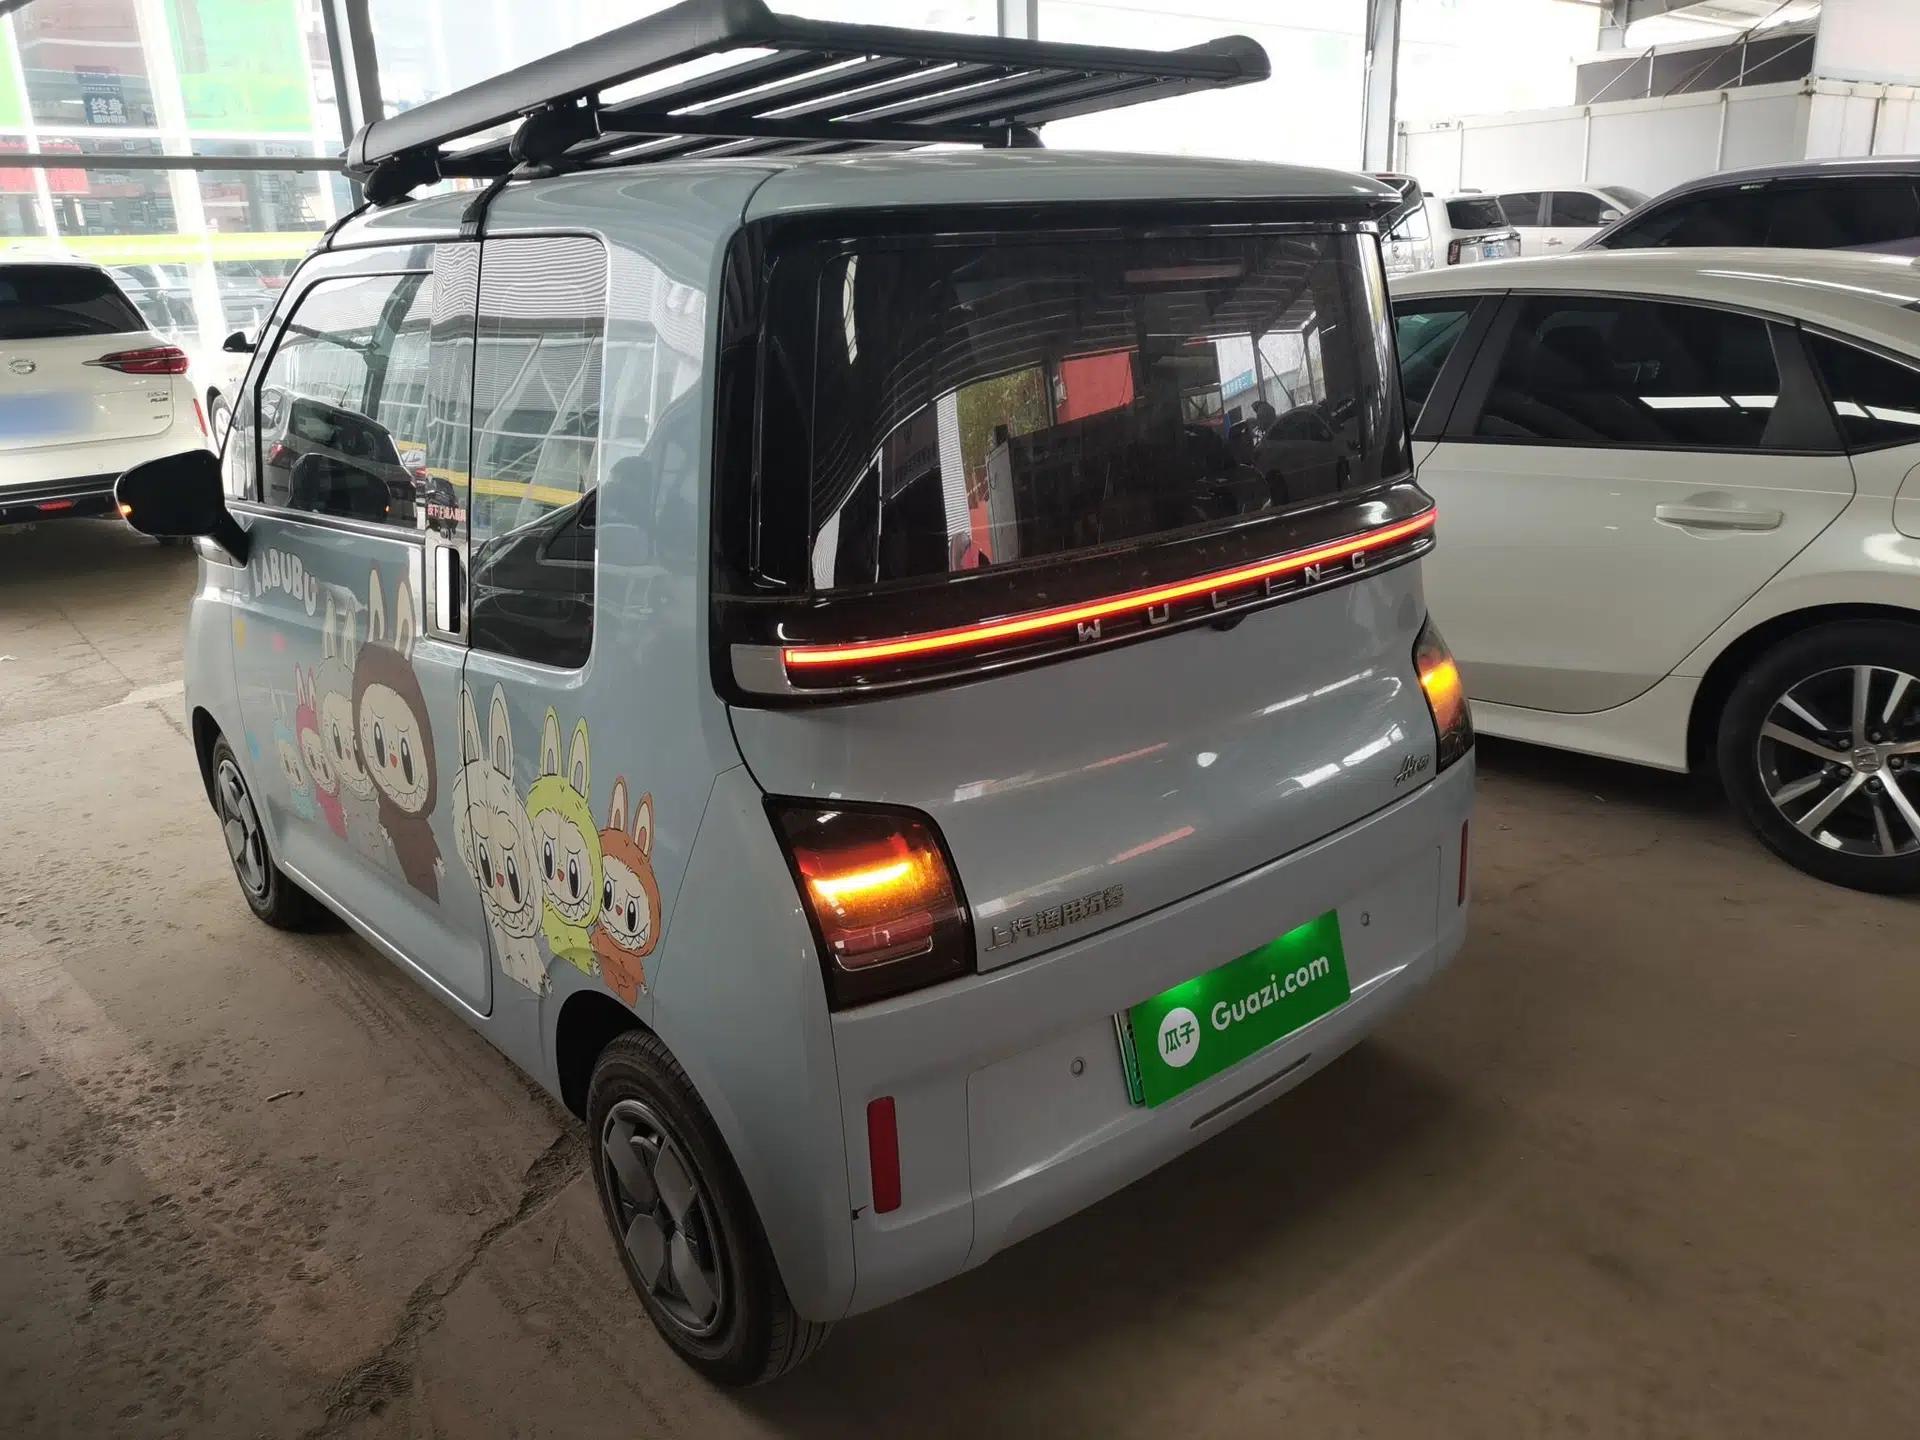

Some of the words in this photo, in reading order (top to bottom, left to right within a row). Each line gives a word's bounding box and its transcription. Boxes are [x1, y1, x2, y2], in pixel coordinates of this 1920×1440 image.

[252, 548, 317, 617] LABUBU
[1078, 551, 1366, 643] WULING
[1165, 1020, 1196, 1054] 瓜子
[1211, 956, 1330, 1031] Guazi.com
